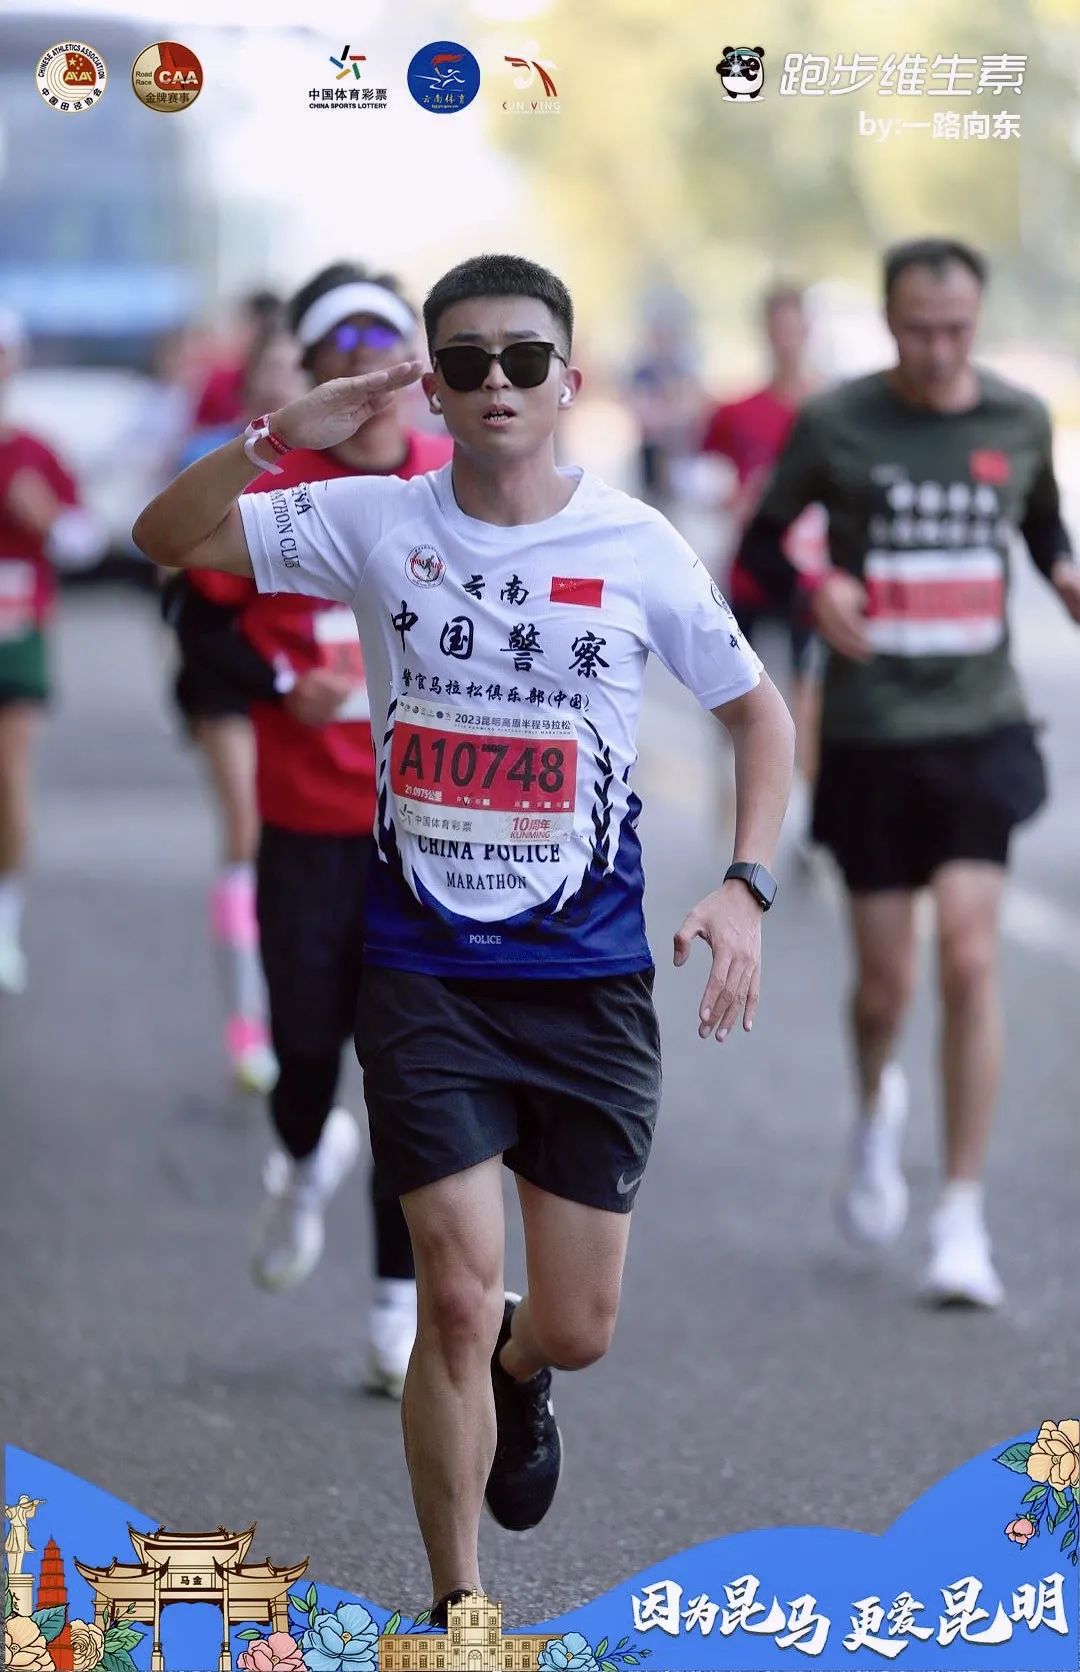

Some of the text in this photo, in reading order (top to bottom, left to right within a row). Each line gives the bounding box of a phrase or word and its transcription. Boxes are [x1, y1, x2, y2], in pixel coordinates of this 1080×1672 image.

[462, 574, 530, 606] 云南
[391, 600, 610, 678] 中国警察
[399, 733, 564, 793] A10748
[415, 814, 473, 833] 中国体育彩票
[512, 817, 551, 831] 10周年
[510, 831, 551, 839] KUNMING
[418, 835, 560, 863] CHINA POLICE
[446, 871, 527, 890] MARATHON
[469, 934, 502, 945] POLICE
